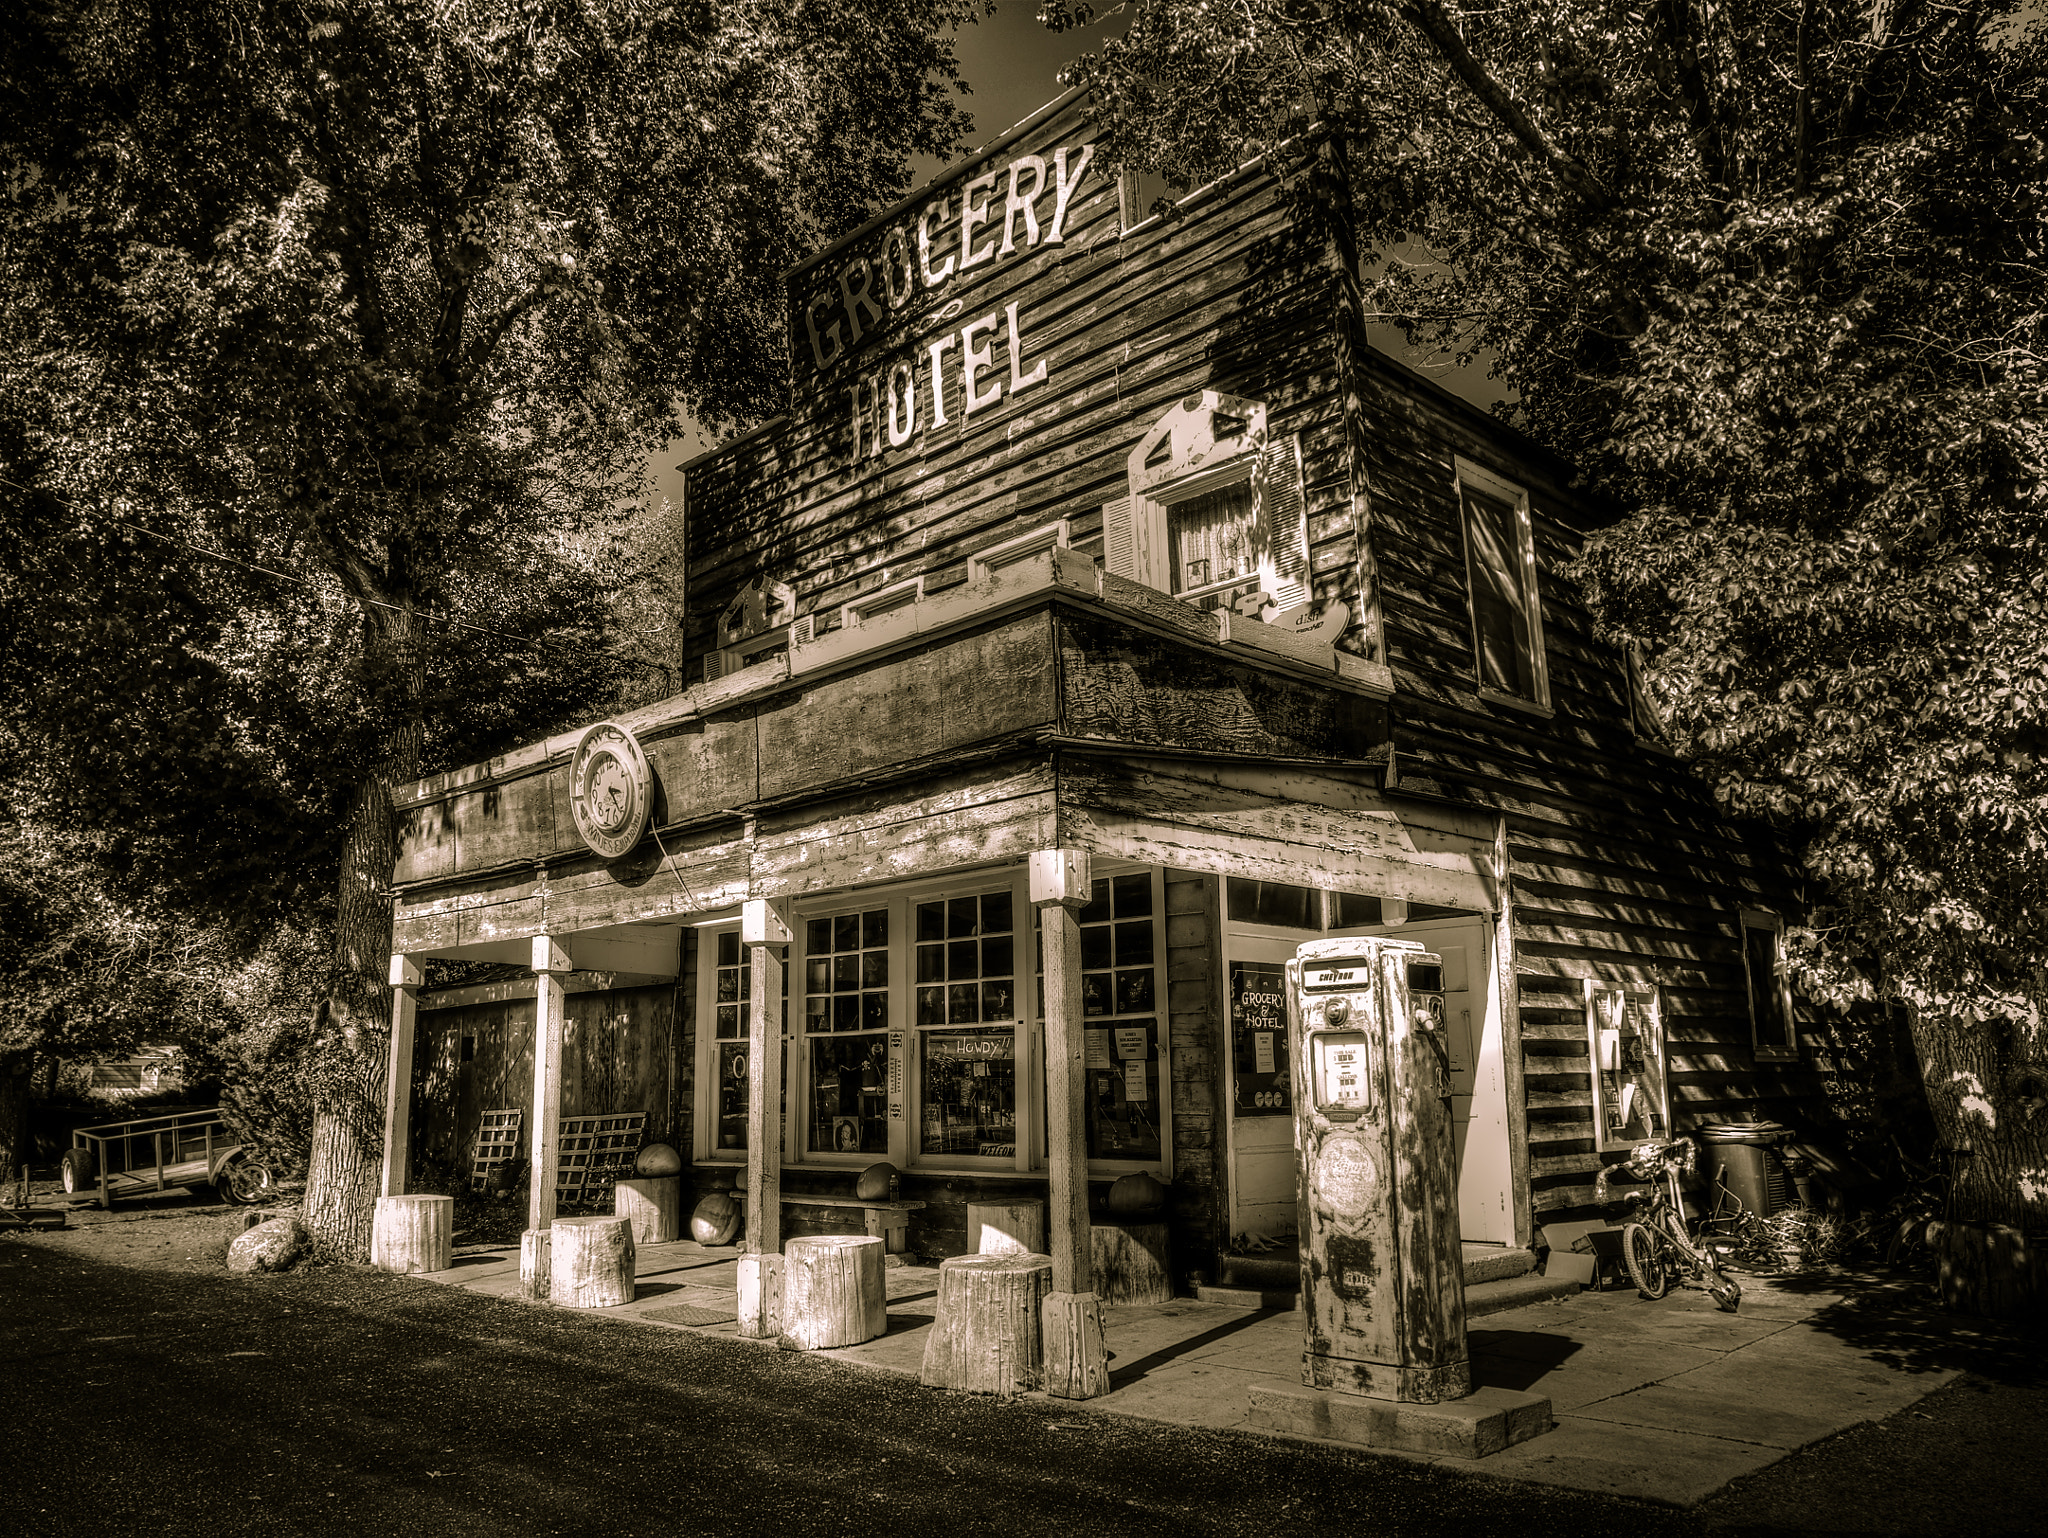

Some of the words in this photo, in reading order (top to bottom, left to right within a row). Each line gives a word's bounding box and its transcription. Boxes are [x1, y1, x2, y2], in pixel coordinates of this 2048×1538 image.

[804, 143, 1095, 371] GROCERY
[851, 301, 1048, 466] HOTEL
[1296, 609, 1319, 625] dish
[592, 788, 598, 805] 9
[598, 801, 604, 817] 8
[613, 808, 619, 824] 6
[1319, 967, 1354, 983] CHEVRON
[1242, 991, 1285, 1008] GROCERY
[1261, 1004, 1270, 1018] &
[1245, 1013, 1284, 1029] HOTEL
